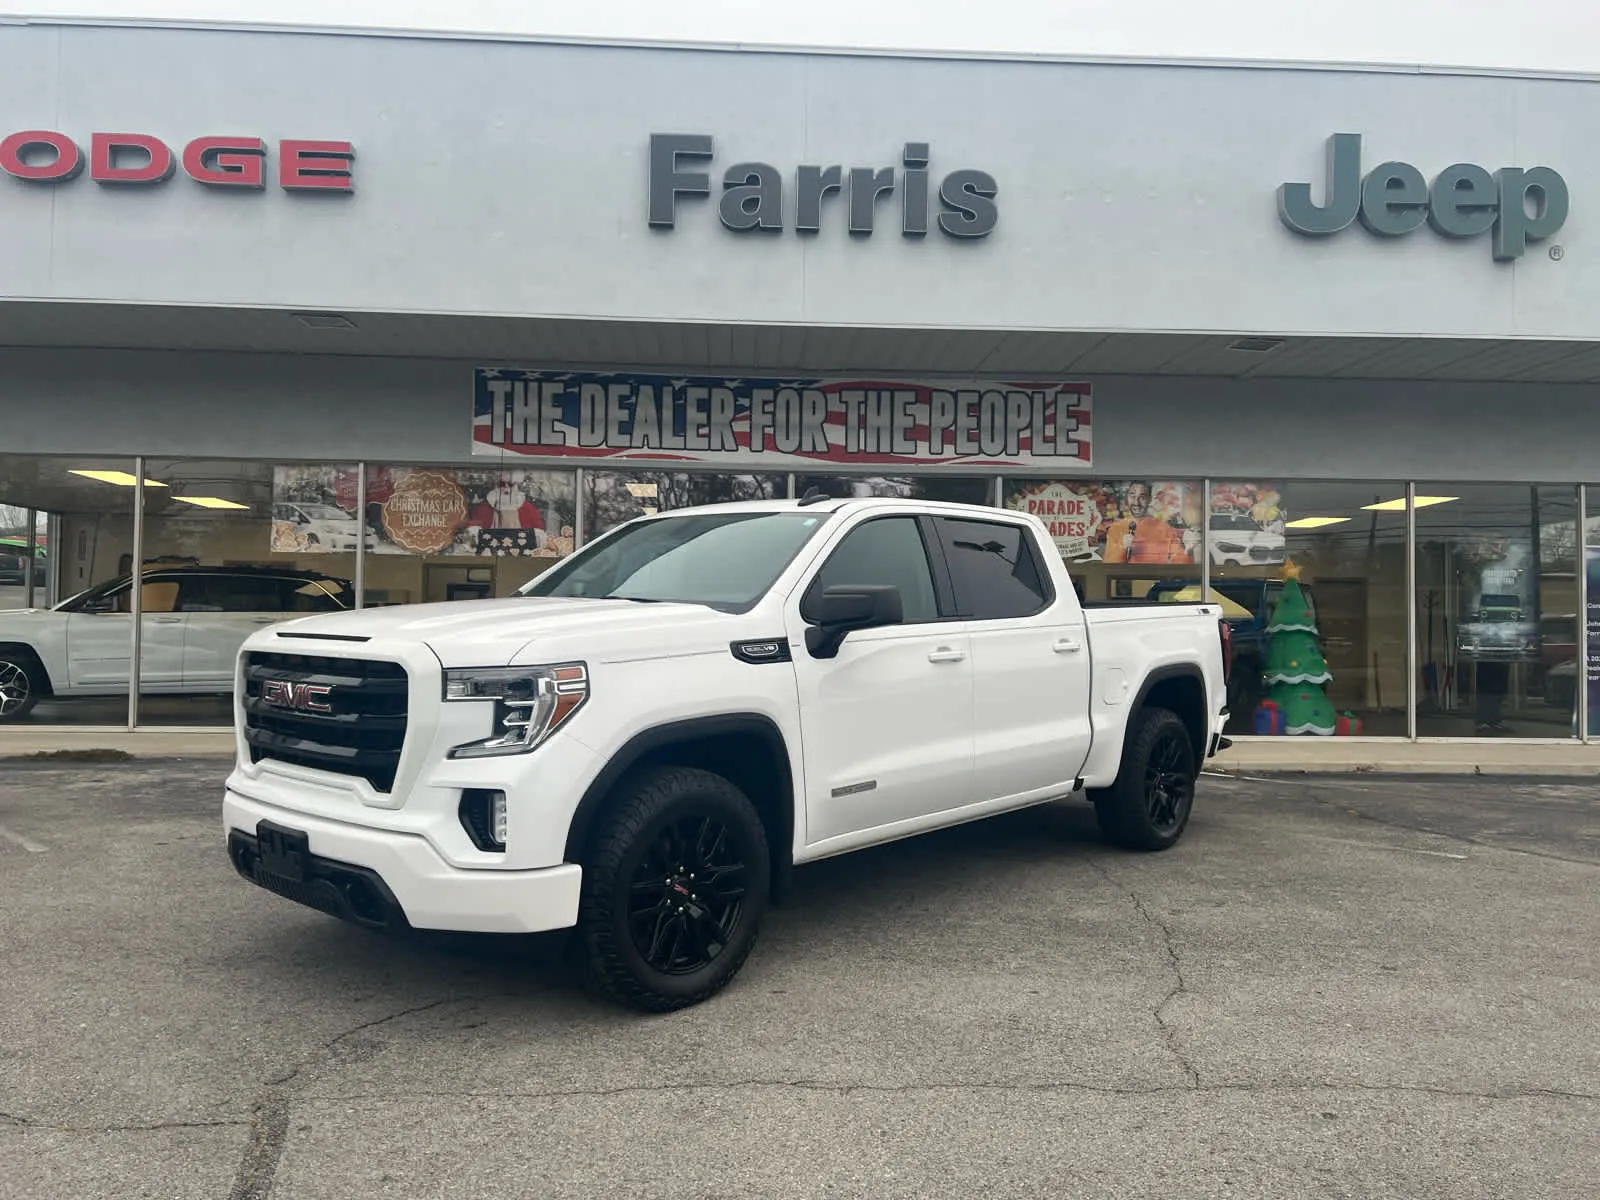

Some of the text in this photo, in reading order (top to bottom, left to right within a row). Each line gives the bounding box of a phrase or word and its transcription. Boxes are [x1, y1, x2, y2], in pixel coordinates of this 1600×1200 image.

[0, 129, 355, 194] ODGE
[647, 132, 999, 239] Farris
[1277, 132, 1569, 261] Jeep
[486, 379, 1082, 457] THE DEALER FOR THE PEOPLE
[390, 495, 460, 513] CHRISTMAS CAR
[402, 513, 449, 528] EXCHANGE
[1028, 499, 1085, 515] PARADE
[1043, 521, 1085, 537] ADES
[262, 680, 333, 713] GMC
